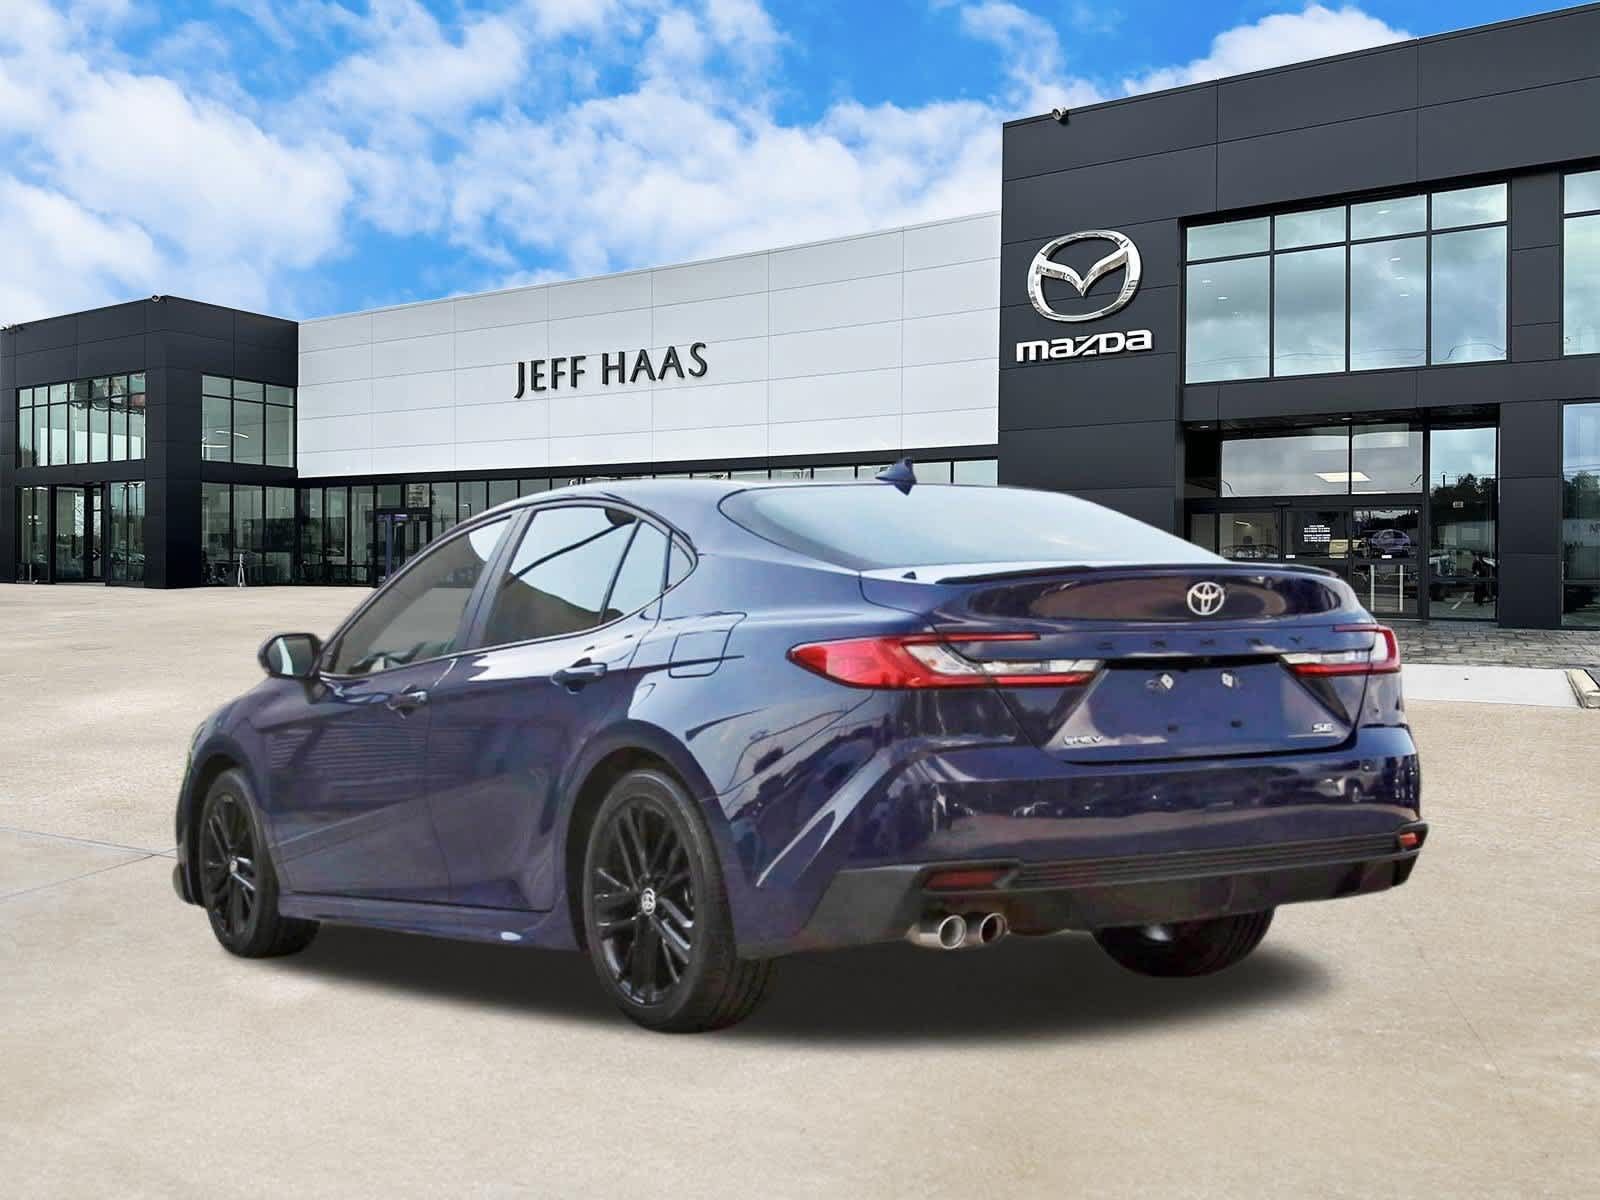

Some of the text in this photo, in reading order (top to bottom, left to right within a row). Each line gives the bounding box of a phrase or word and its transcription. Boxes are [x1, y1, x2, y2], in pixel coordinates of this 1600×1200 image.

[1016, 329, 1153, 363] mazda
[514, 342, 708, 399] JEFF HAAS
